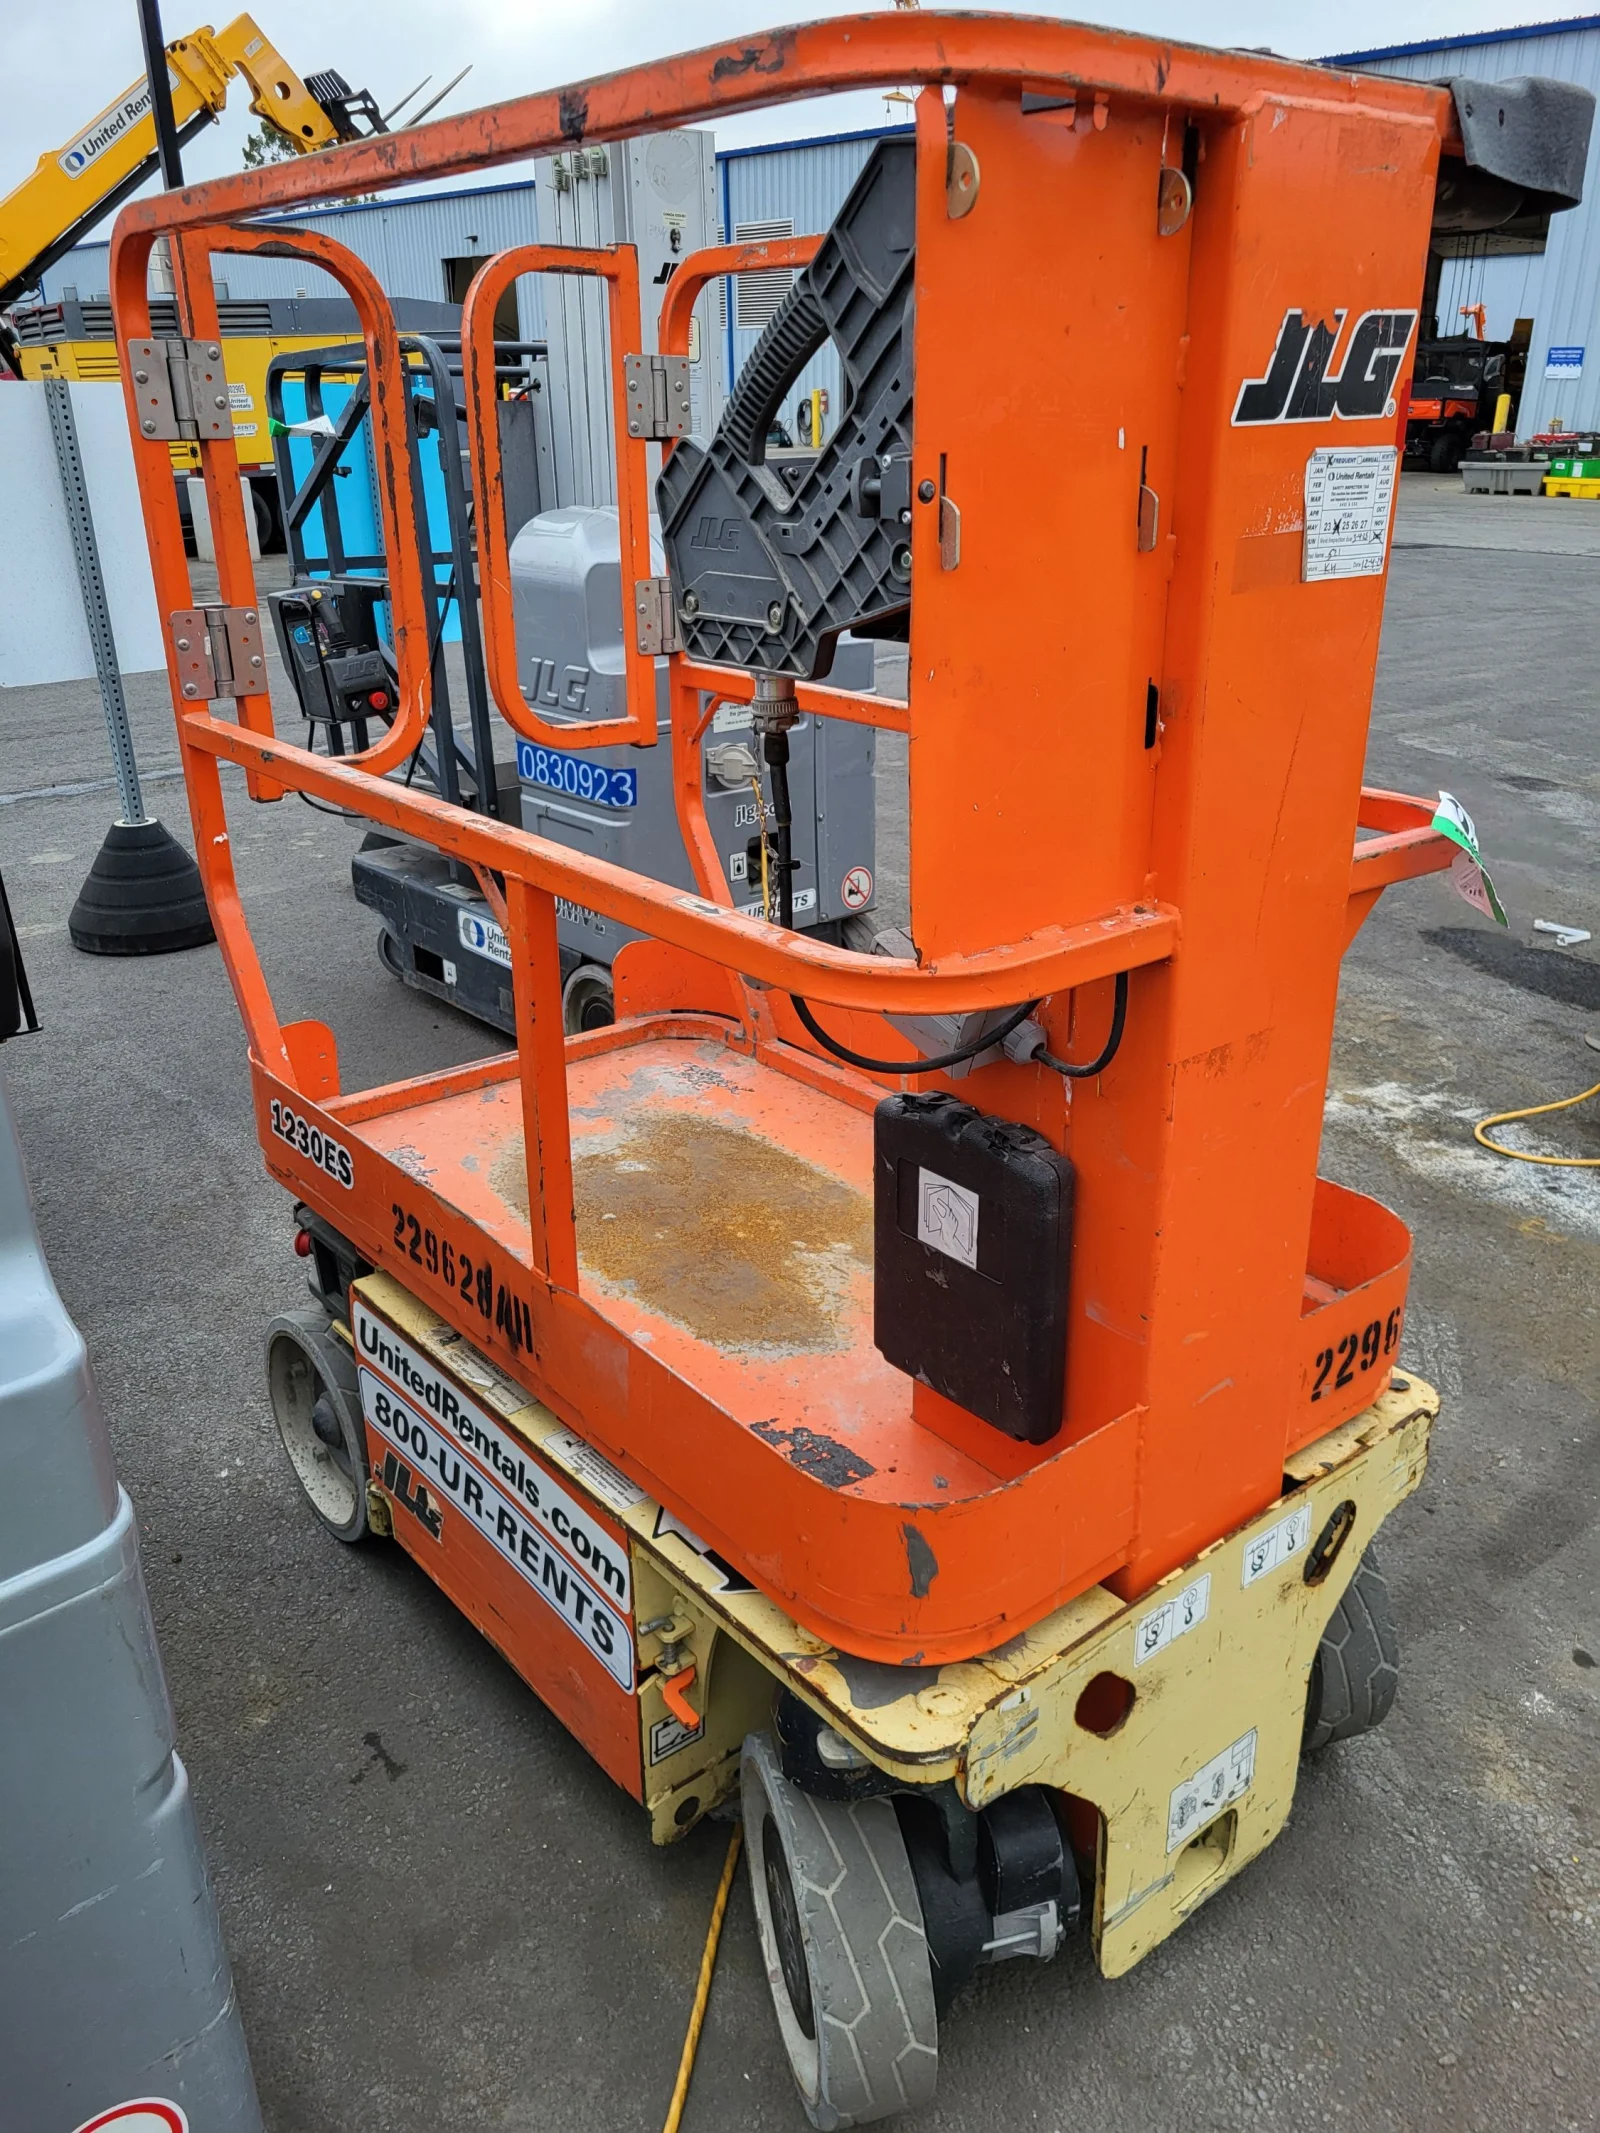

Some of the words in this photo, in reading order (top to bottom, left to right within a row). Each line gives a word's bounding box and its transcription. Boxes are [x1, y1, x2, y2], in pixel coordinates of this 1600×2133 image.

[82, 113, 127, 156] United
[124, 88, 152, 120] Ren
[1232, 308, 1417, 426] JLG
[1336, 472, 1354, 480] United
[690, 517, 742, 552] JLG
[1324, 522, 1331, 531] 23
[1342, 521, 1349, 530] 25
[1351, 521, 1358, 529] 26
[1360, 520, 1368, 528] 27
[518, 656, 590, 713] JLG
[522, 745, 634, 807] 0830923
[735, 802, 776, 828] jlg.co
[488, 940, 512, 962] Renta
[271, 1100, 353, 1188] 1230ES
[360, 1317, 626, 1598] UnitedRentals.com
[374, 1391, 615, 1655] 800-UR-RENTS
